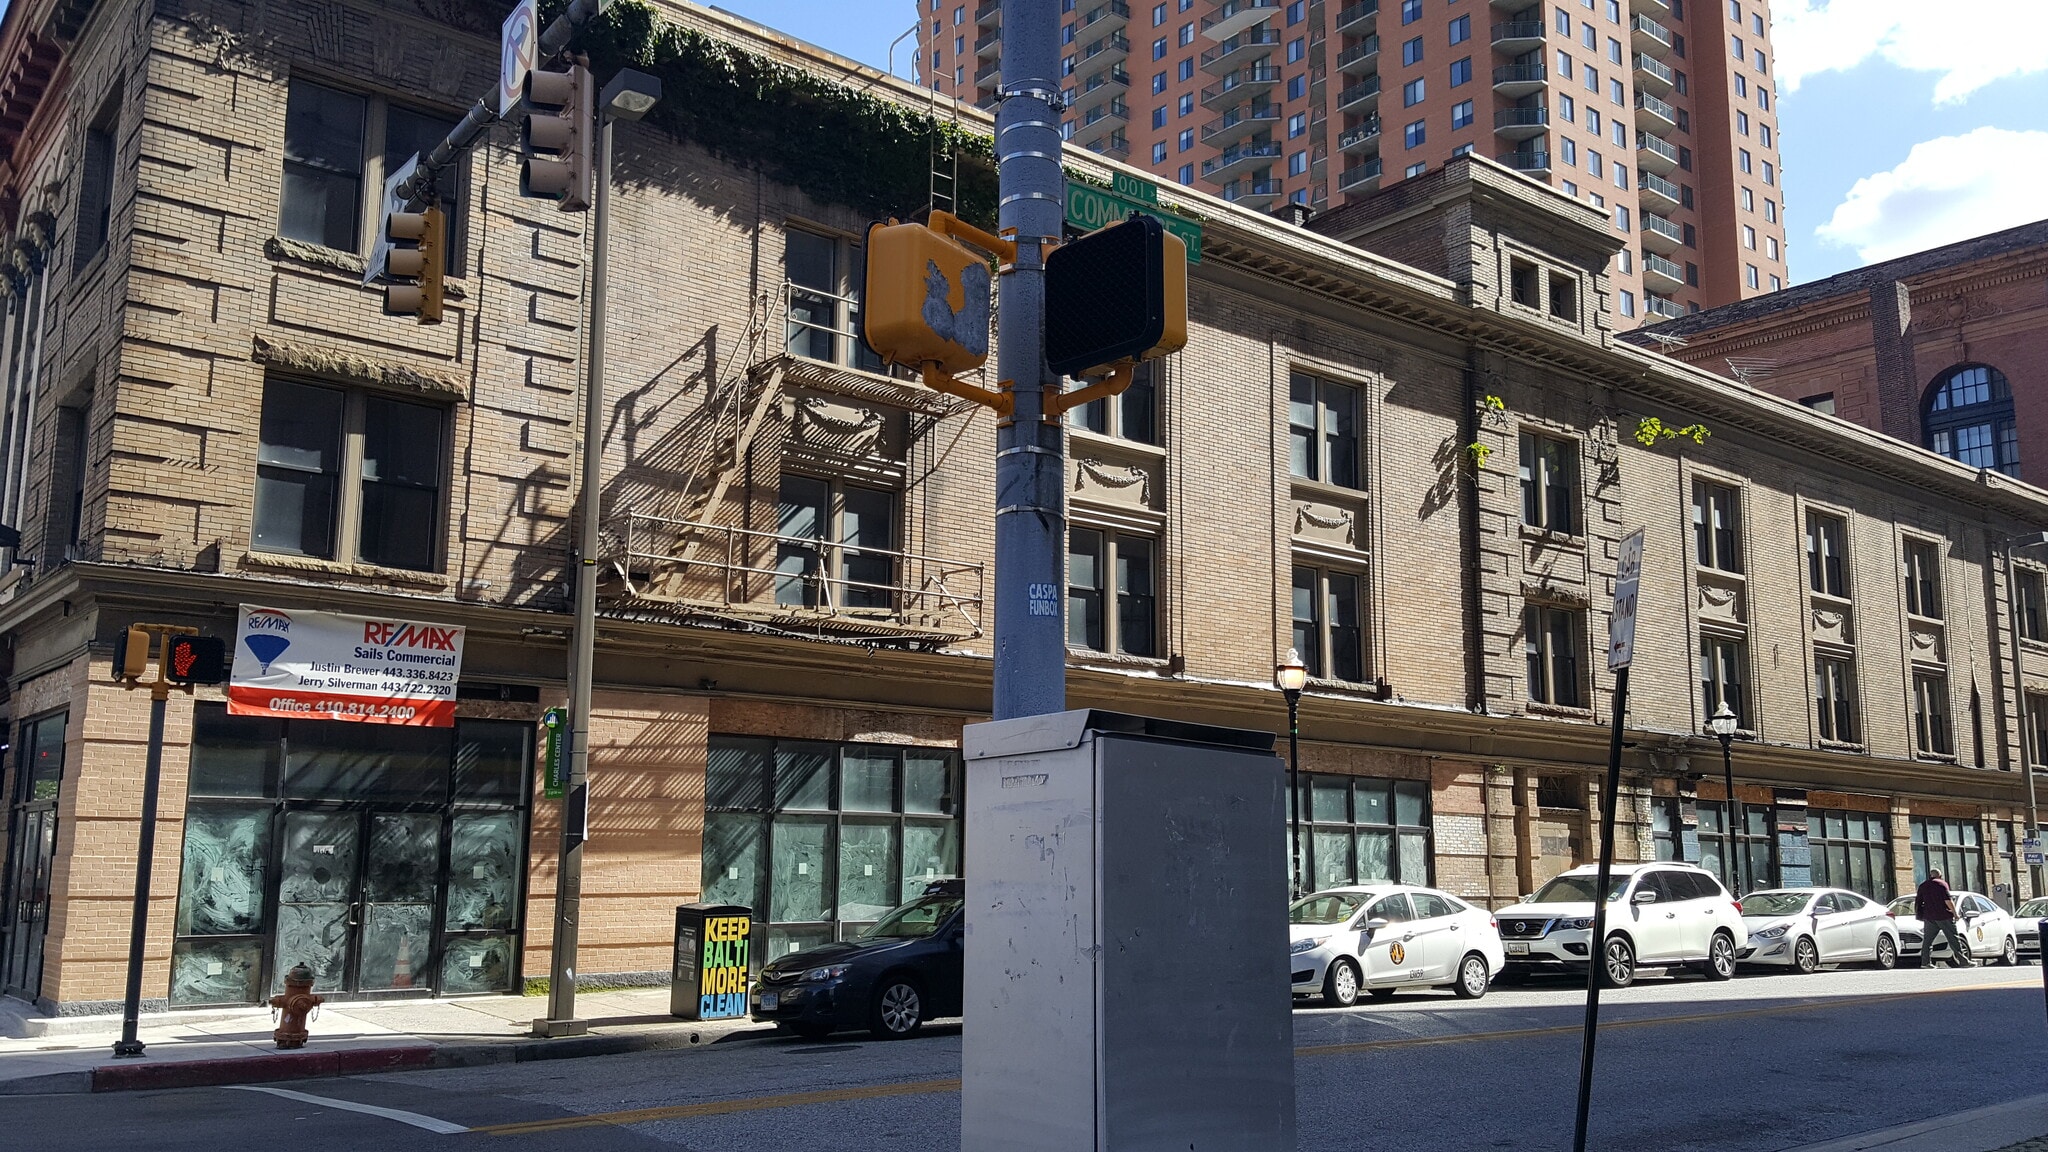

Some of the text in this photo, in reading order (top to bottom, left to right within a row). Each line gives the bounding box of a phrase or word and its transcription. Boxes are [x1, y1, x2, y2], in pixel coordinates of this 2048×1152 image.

[1614, 594, 1634, 623] STAND
[248, 615, 291, 633] RE/MAX
[364, 621, 458, 652] RE/MAX
[354, 647, 456, 667] Sails Commercial
[310, 661, 453, 682] Justin Brewer 443.336.8423
[298, 675, 451, 696] Jerry Silverman 443.722.2320
[269, 697, 415, 719] Office 410.814.2400
[553, 758, 561, 787] CHARLES
[705, 917, 749, 942] KEEP
[703, 940, 748, 968] BALTI
[701, 966, 747, 995] MORE
[701, 993, 745, 1018] CLEAN
